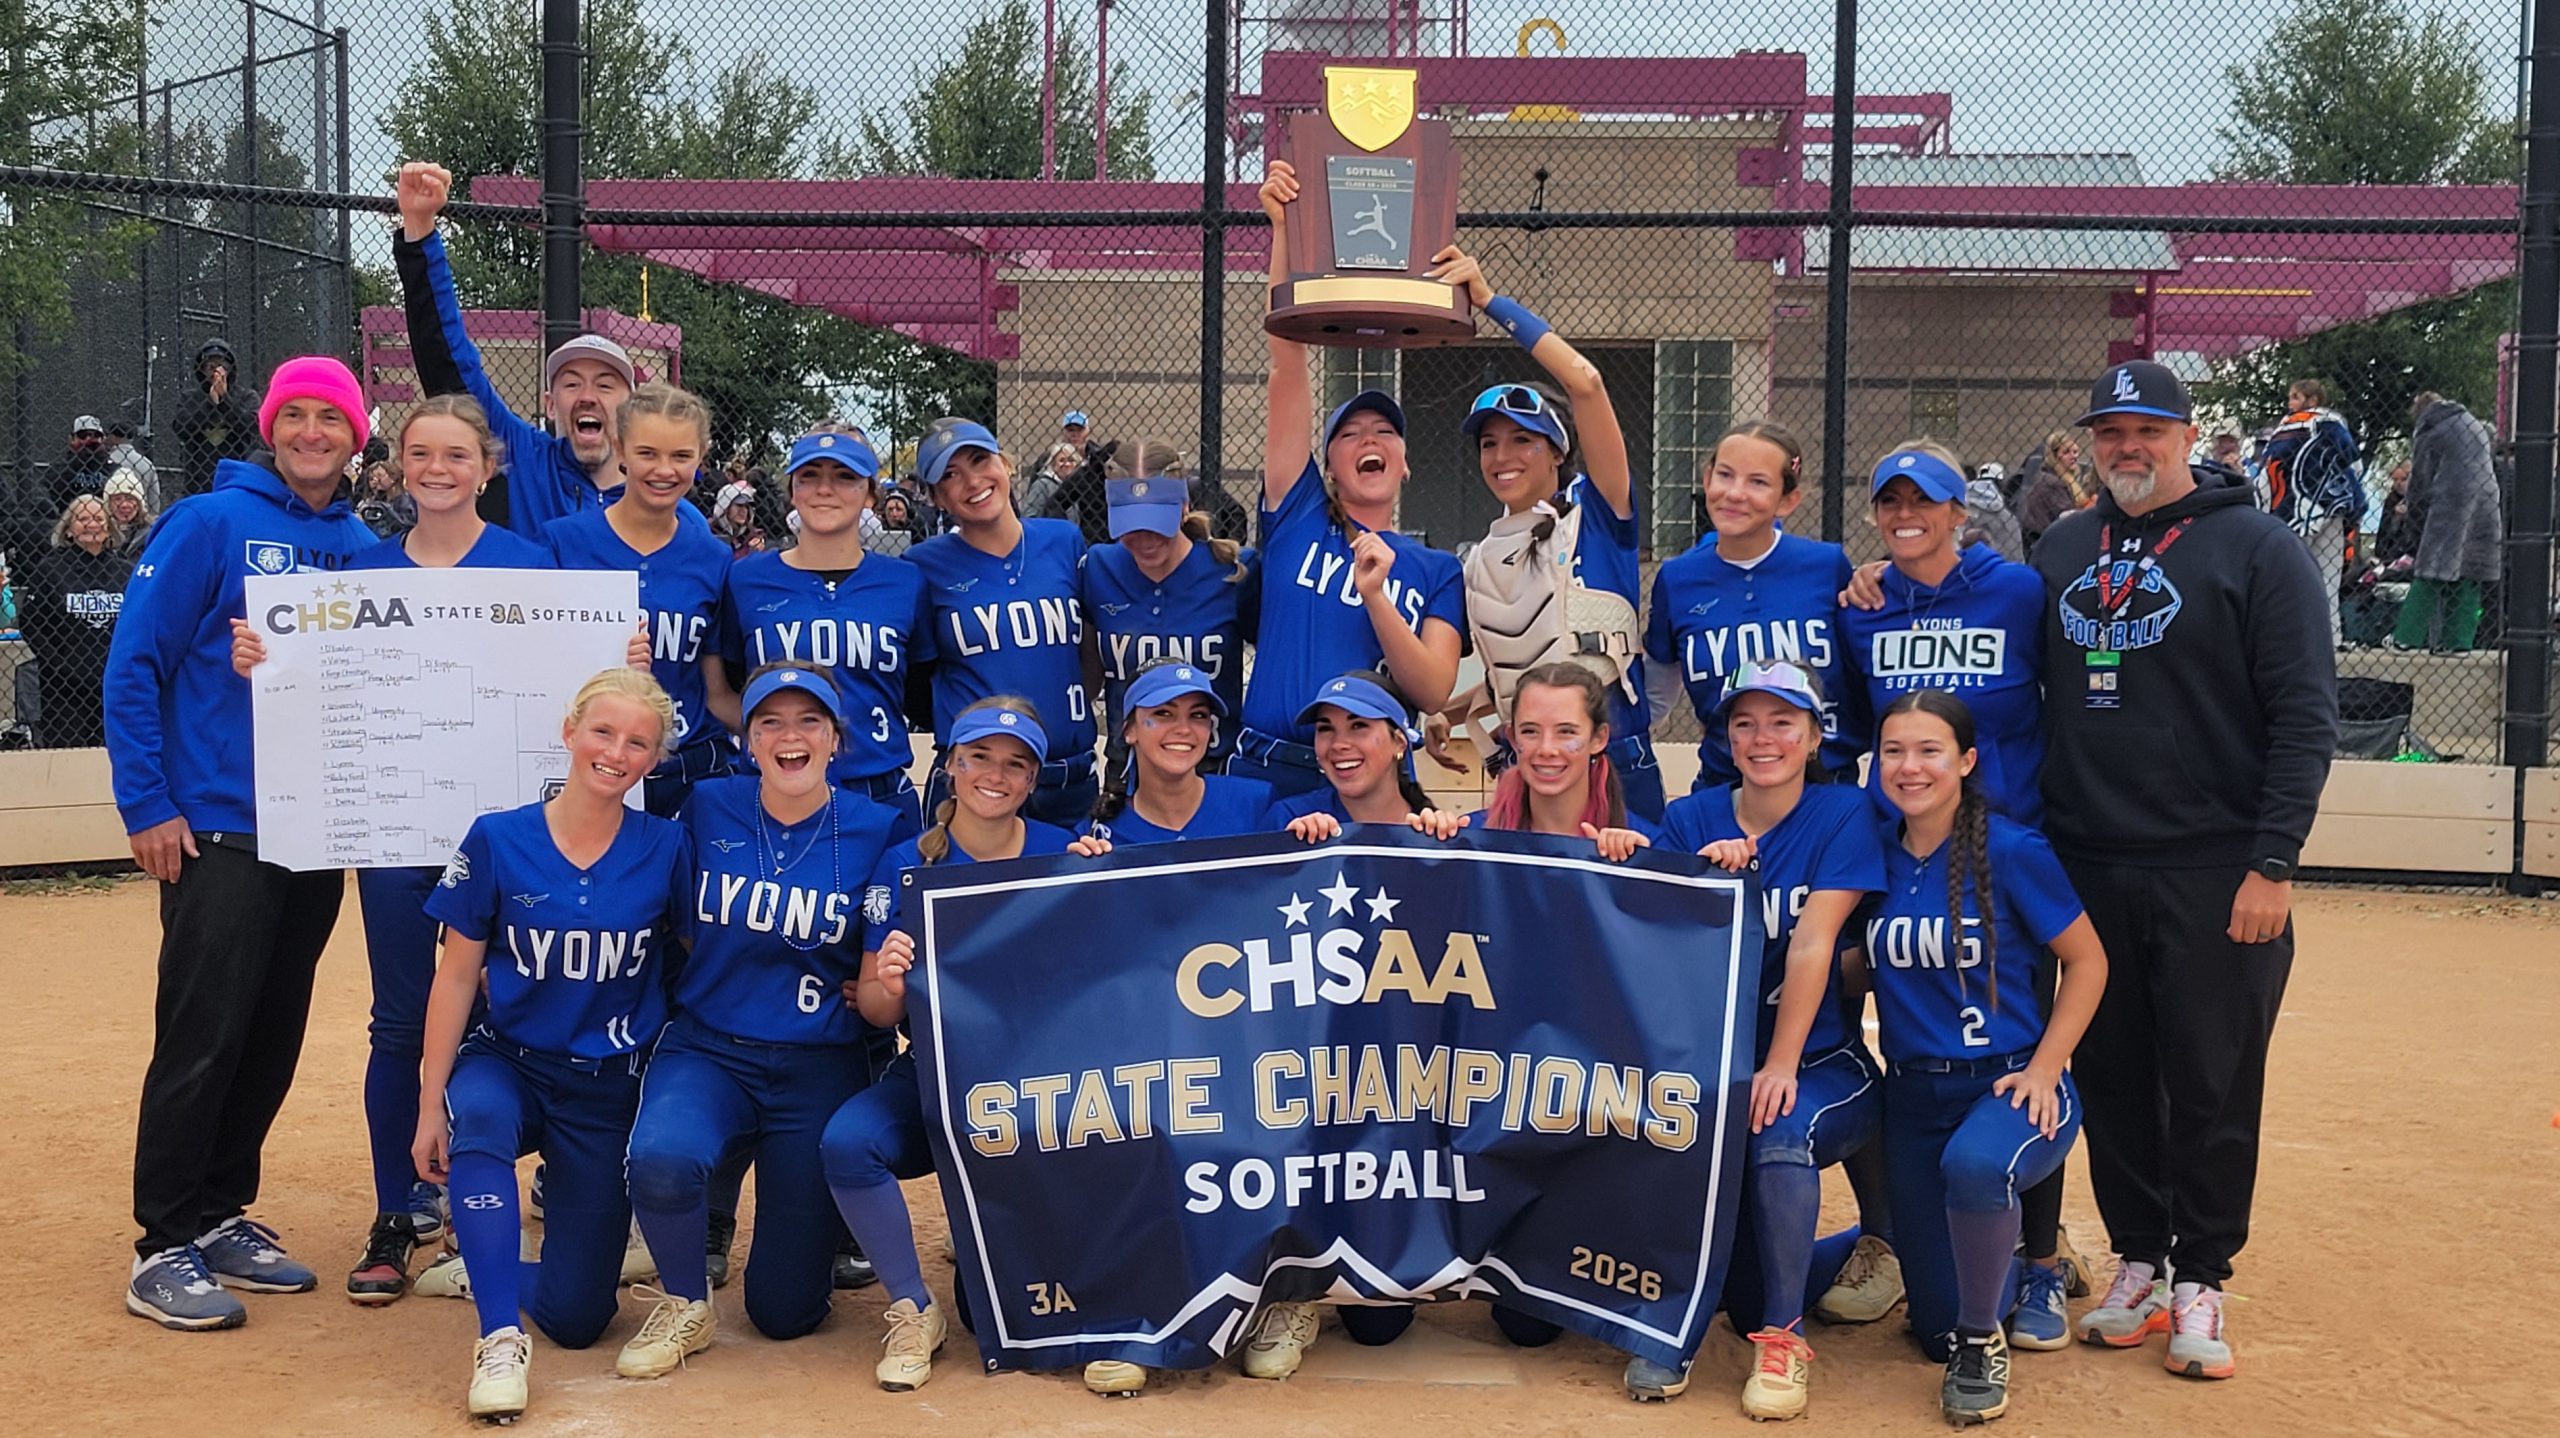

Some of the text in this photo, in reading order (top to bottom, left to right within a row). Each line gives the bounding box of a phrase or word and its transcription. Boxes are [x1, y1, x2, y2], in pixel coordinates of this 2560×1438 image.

[1345, 167, 1396, 177] SOFTBALL
[1355, 257, 1388, 265] CHSAA
[2078, 560, 2164, 594] LOS
[70, 594, 122, 611] LIONS
[266, 597, 627, 635] CHSAA STATE 3A SOFTBALL
[754, 619, 898, 673] LYONS
[950, 597, 1083, 656] LYONS
[2063, 612, 2164, 651] FOOBALL
[1686, 618, 1832, 683] LYONS
[1879, 633, 1997, 672] LIONS
[1885, 674, 1986, 690] SOFTBALL
[1066, 684, 1086, 721] 10
[870, 706, 890, 742] 3
[698, 870, 850, 945] LYONS
[506, 925, 653, 983] LYONS
[1866, 916, 1983, 969] YONS
[1175, 928, 1497, 1018] CHSAA
[797, 974, 824, 1014] 6
[606, 1014, 637, 1050] 11
[1959, 1006, 1990, 1047] 2
[965, 1043, 1703, 1158] STATE CHAMPIONS
[1184, 1149, 1486, 1214] SOFTBALL
[1569, 1246, 1662, 1302] 2026
[1028, 1282, 1078, 1316] 3A
